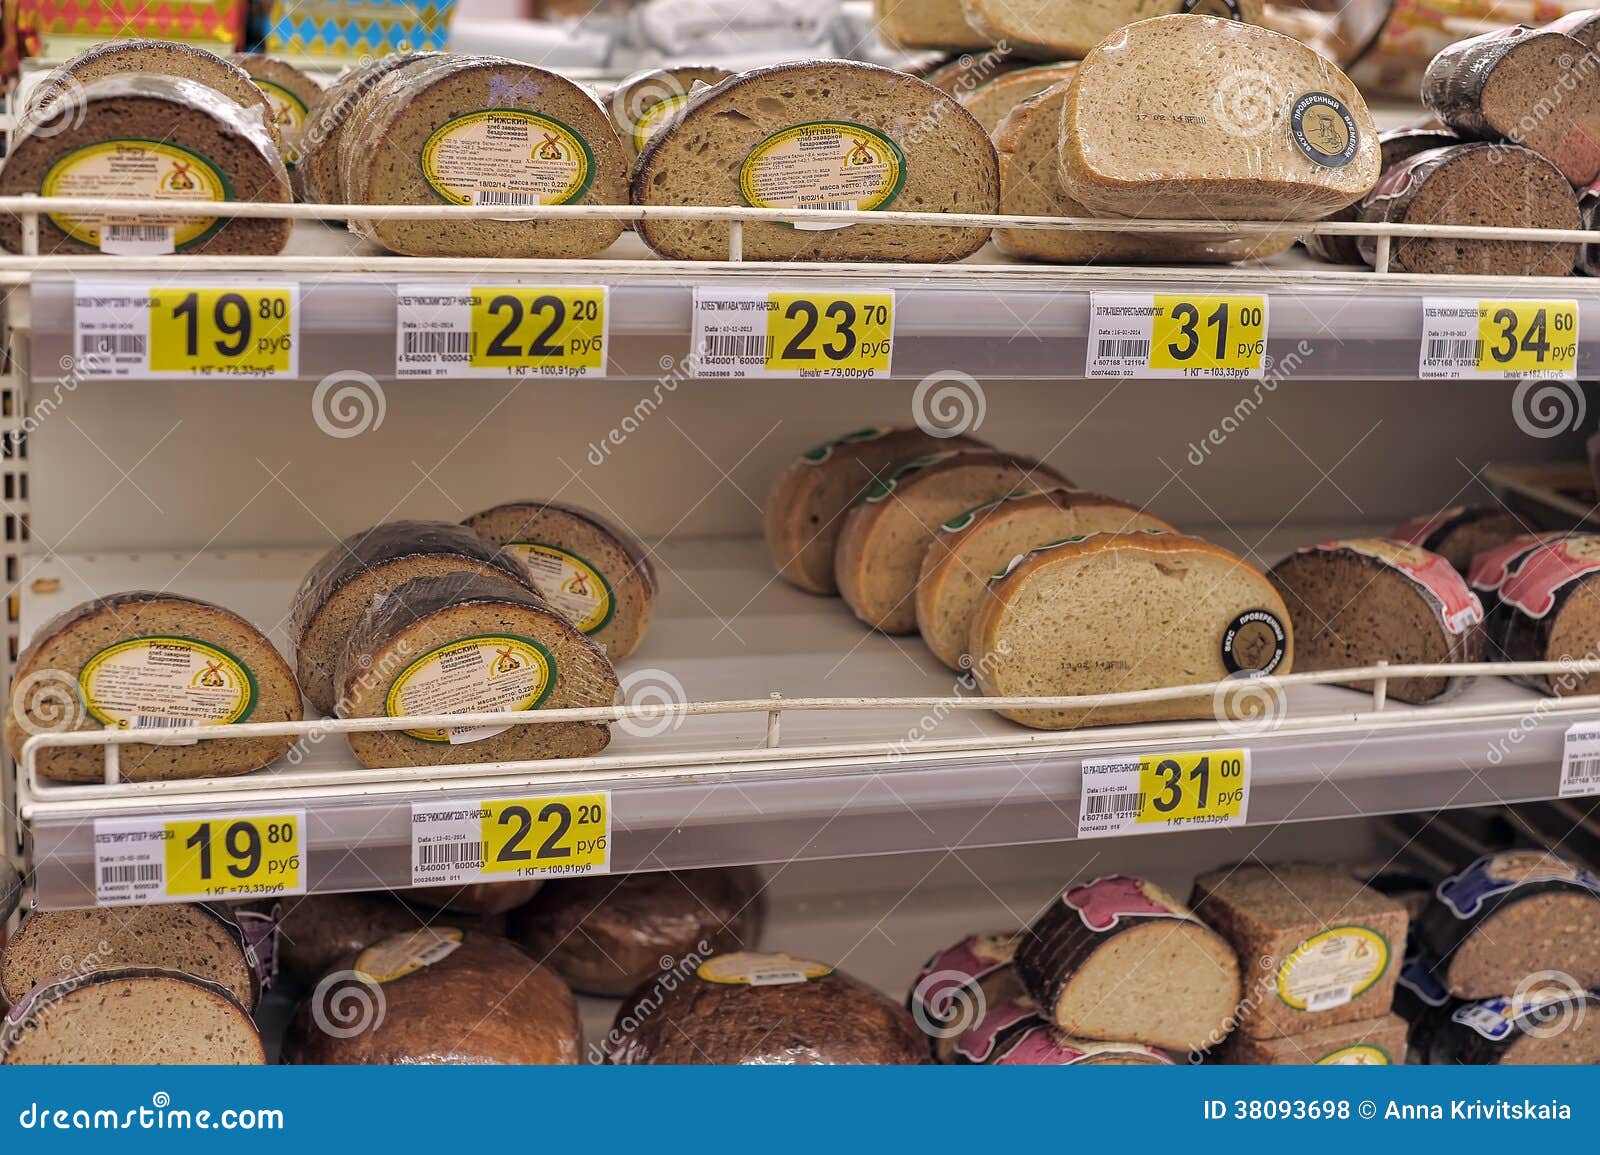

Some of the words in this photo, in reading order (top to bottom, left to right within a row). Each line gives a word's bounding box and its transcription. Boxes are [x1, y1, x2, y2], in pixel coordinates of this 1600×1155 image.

[1294, 95, 1340, 120] ПРОВЕРЕННЫЙ
[487, 115, 528, 126] Рижский
[800, 127, 837, 136] Митава
[1297, 131, 1312, 152] ВКУС
[1344, 115, 1357, 159] ВРЕМЕНЕМ
[819, 183, 840, 191] масса
[797, 194, 824, 202] 18/02/14
[258, 298, 286, 319] 80
[572, 300, 598, 321] 20
[863, 305, 888, 325] 70
[1240, 307, 1262, 327] 00
[172, 292, 252, 357] 19
[486, 295, 567, 357] 22
[781, 300, 857, 361] 23
[1168, 303, 1229, 361] 31
[1554, 313, 1573, 331] 60
[258, 334, 292, 355] руб
[571, 336, 603, 355] руб
[1491, 308, 1551, 363] 34
[861, 339, 891, 358] руб
[1237, 340, 1264, 358] руб
[1552, 343, 1576, 361] руб
[1224, 629, 1235, 652] ВКУС
[438, 643, 479, 660] Рижский
[477, 697, 497, 705] масса
[1221, 760, 1240, 777] 00
[1153, 757, 1210, 812] 31
[1218, 788, 1243, 805] руб
[578, 805, 602, 824] 20
[268, 823, 293, 844] 80
[497, 803, 572, 862] 22
[187, 821, 262, 880] 19
[577, 835, 606, 854] руб
[268, 855, 300, 874] руб
